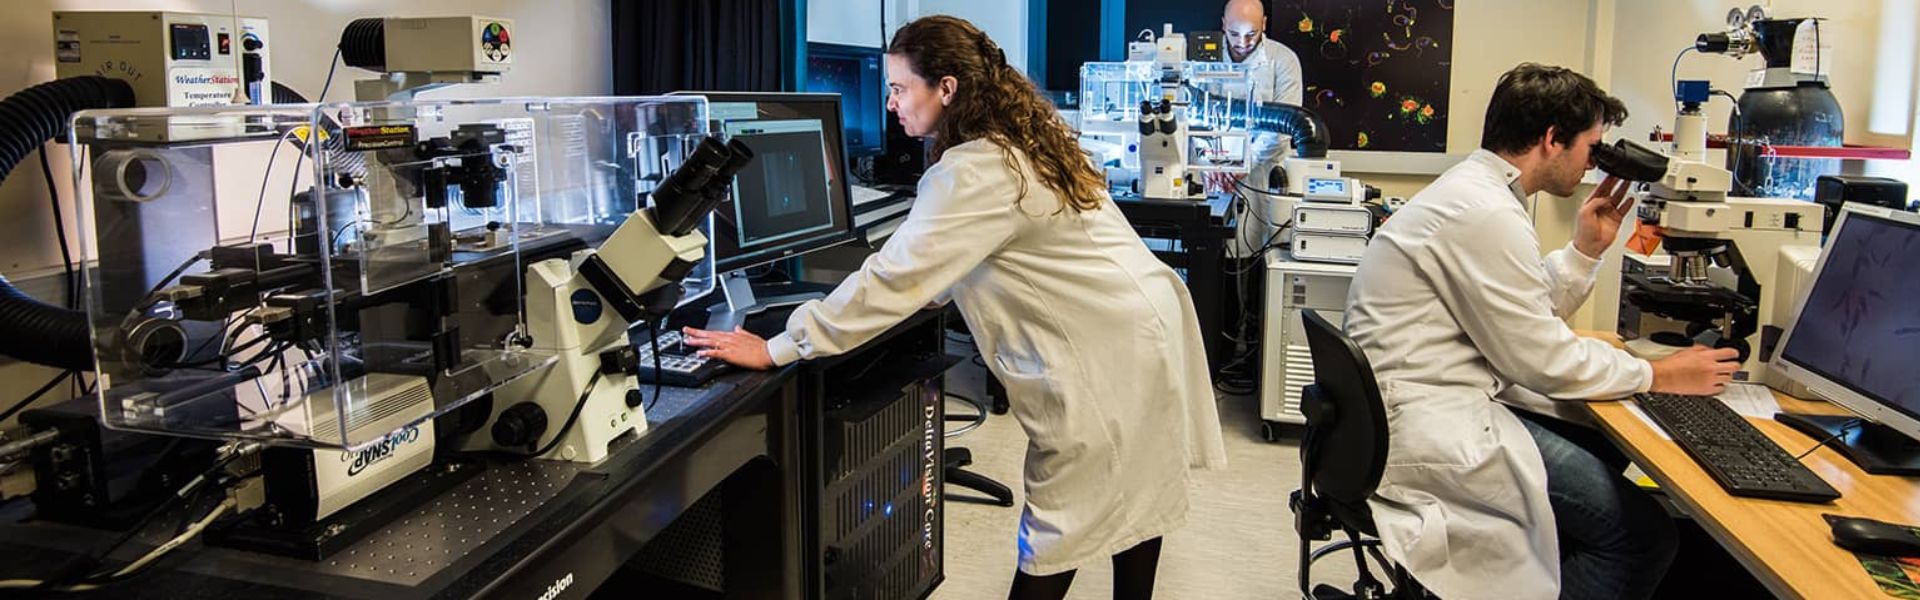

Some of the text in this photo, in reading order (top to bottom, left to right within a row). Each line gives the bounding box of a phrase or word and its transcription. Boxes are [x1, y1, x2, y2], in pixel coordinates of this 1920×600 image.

[120, 61, 143, 80] OUT
[184, 91, 231, 100] Temperature
[924, 405, 935, 549] DeltaVision Core
[537, 572, 573, 600] cision
